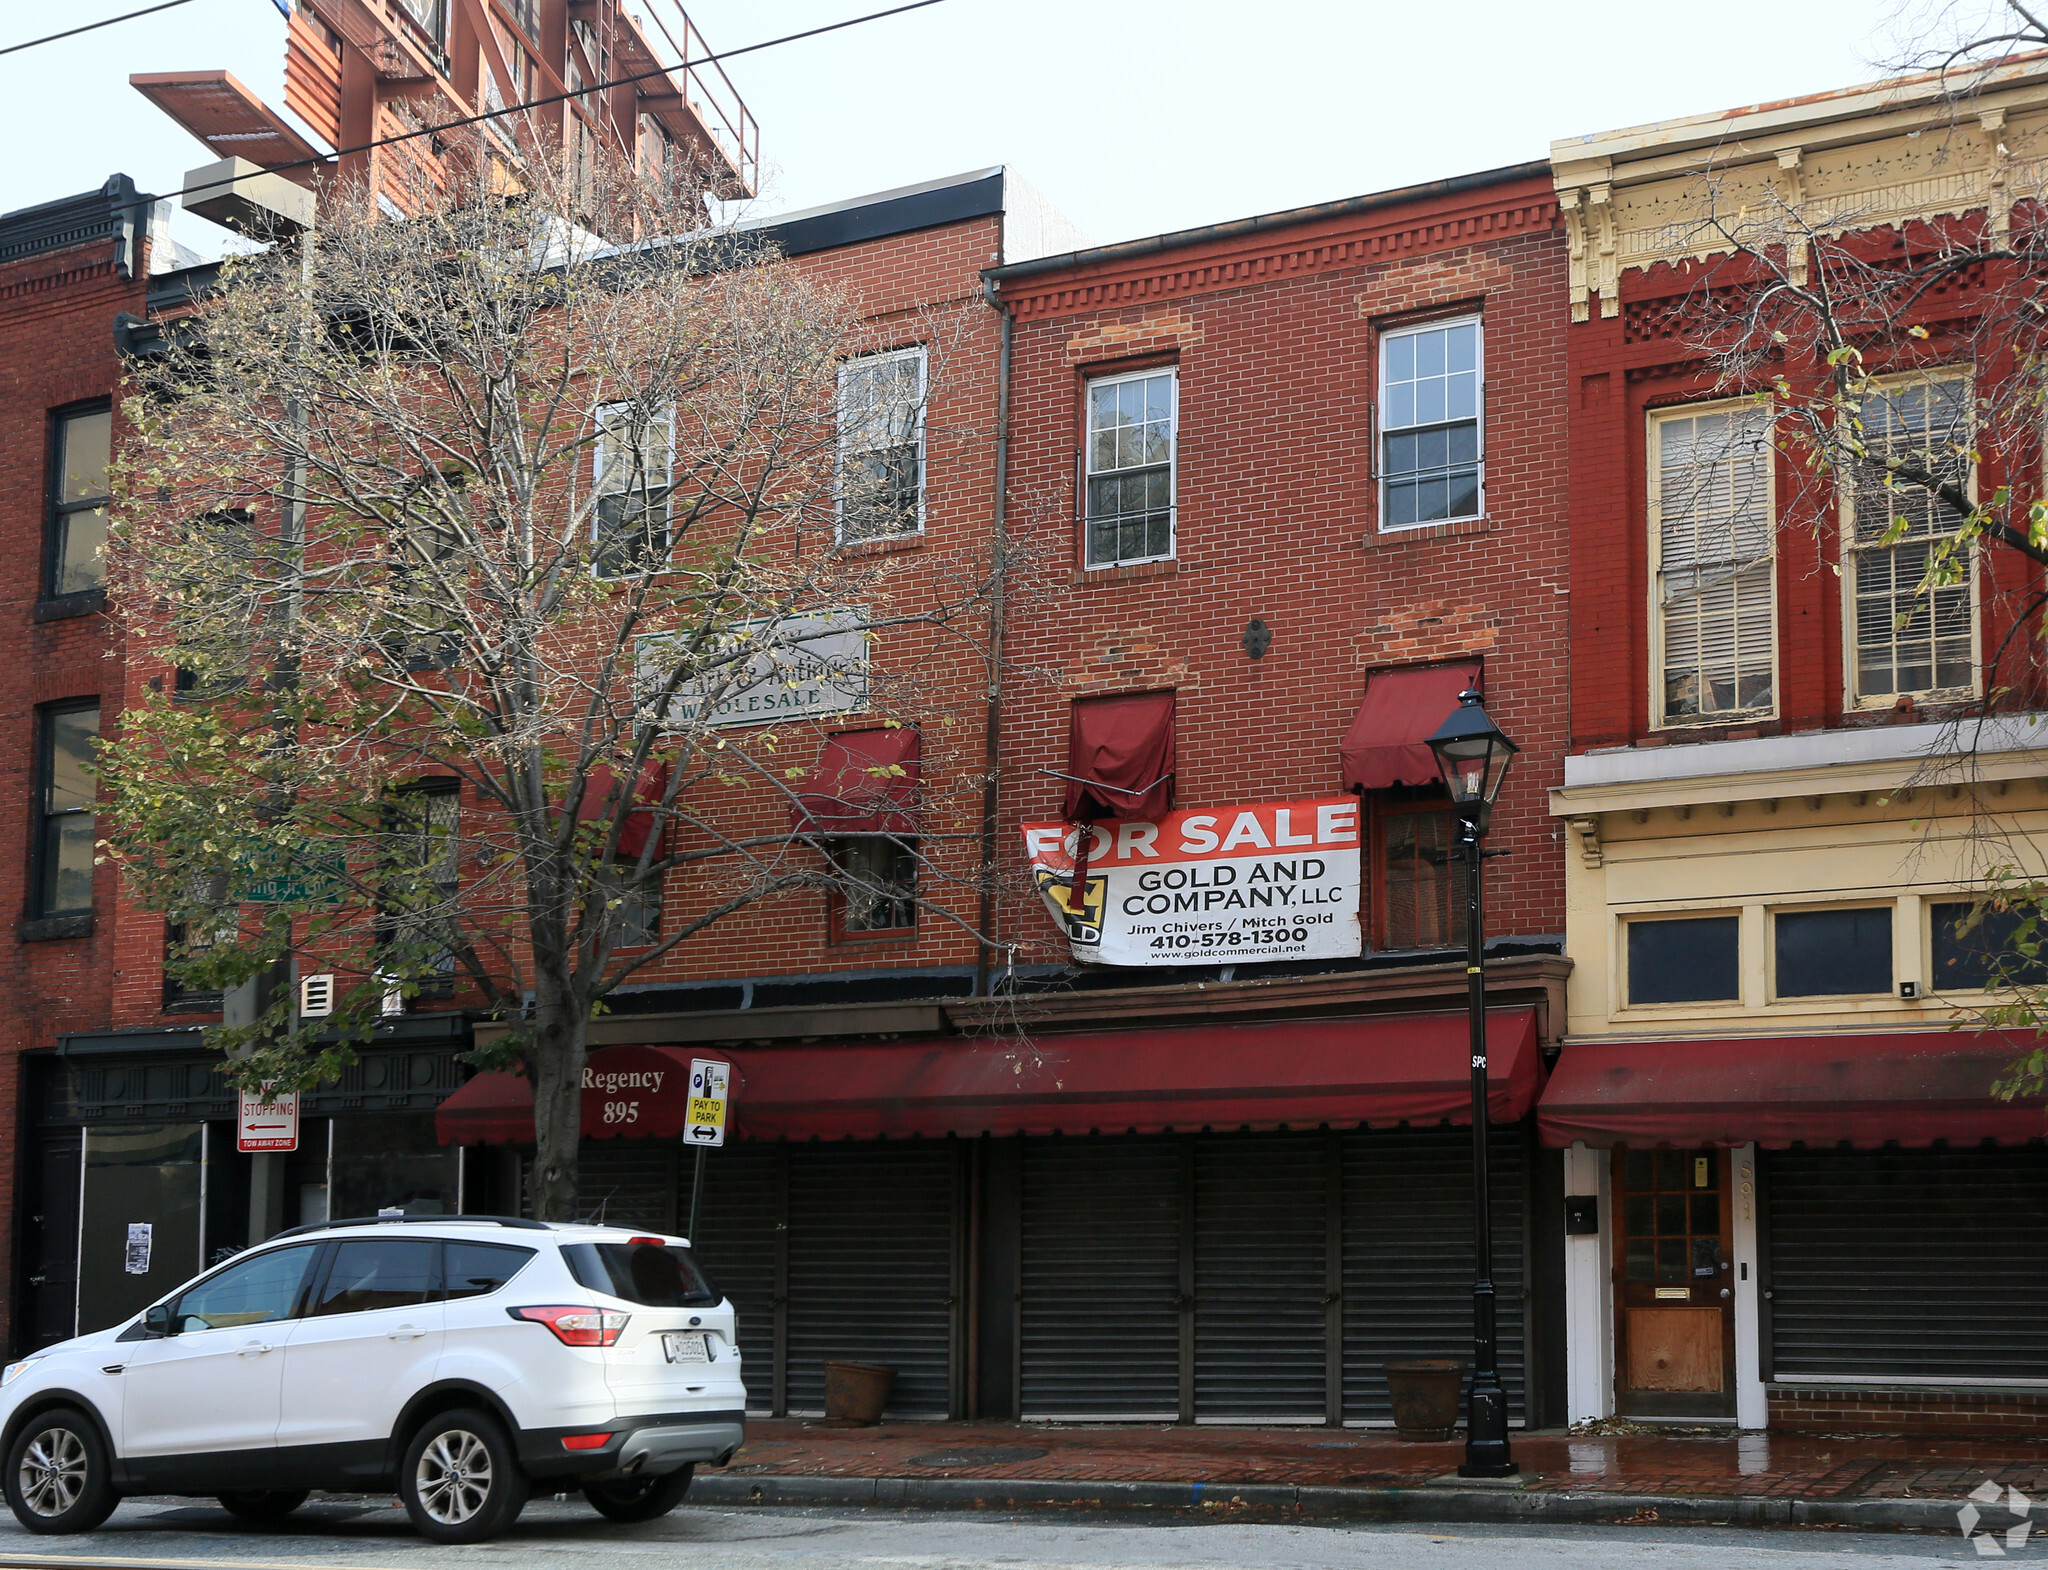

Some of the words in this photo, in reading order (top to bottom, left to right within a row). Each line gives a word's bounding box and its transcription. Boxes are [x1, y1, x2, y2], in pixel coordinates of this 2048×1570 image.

[737, 666, 757, 689] &
[682, 690, 821, 720] WOLESALE
[1027, 821, 1160, 862] FOR
[1179, 802, 1358, 854] SALE
[1138, 865, 1237, 892] GOLD
[1247, 858, 1326, 884] AND
[1122, 885, 1298, 916] COMPANY,
[1302, 887, 1343, 905] LLC
[1127, 924, 1156, 936] Jim
[1162, 920, 1223, 934] Chivers
[1227, 917, 1237, 931] /
[1242, 916, 1287, 929] Mitch
[1293, 913, 1334, 926] Gold
[1150, 928, 1309, 949] 410-578-1300
[1150, 945, 1306, 960] www.goldcommercial.net
[1472, 1055, 1487, 1069] SPC
[581, 1067, 665, 1094] Regency
[243, 1102, 294, 1116] STOPPING
[603, 1101, 639, 1124] 895
[694, 1100, 709, 1110] PAY
[711, 1101, 721, 1111] TO
[696, 1112, 717, 1123] PARK
